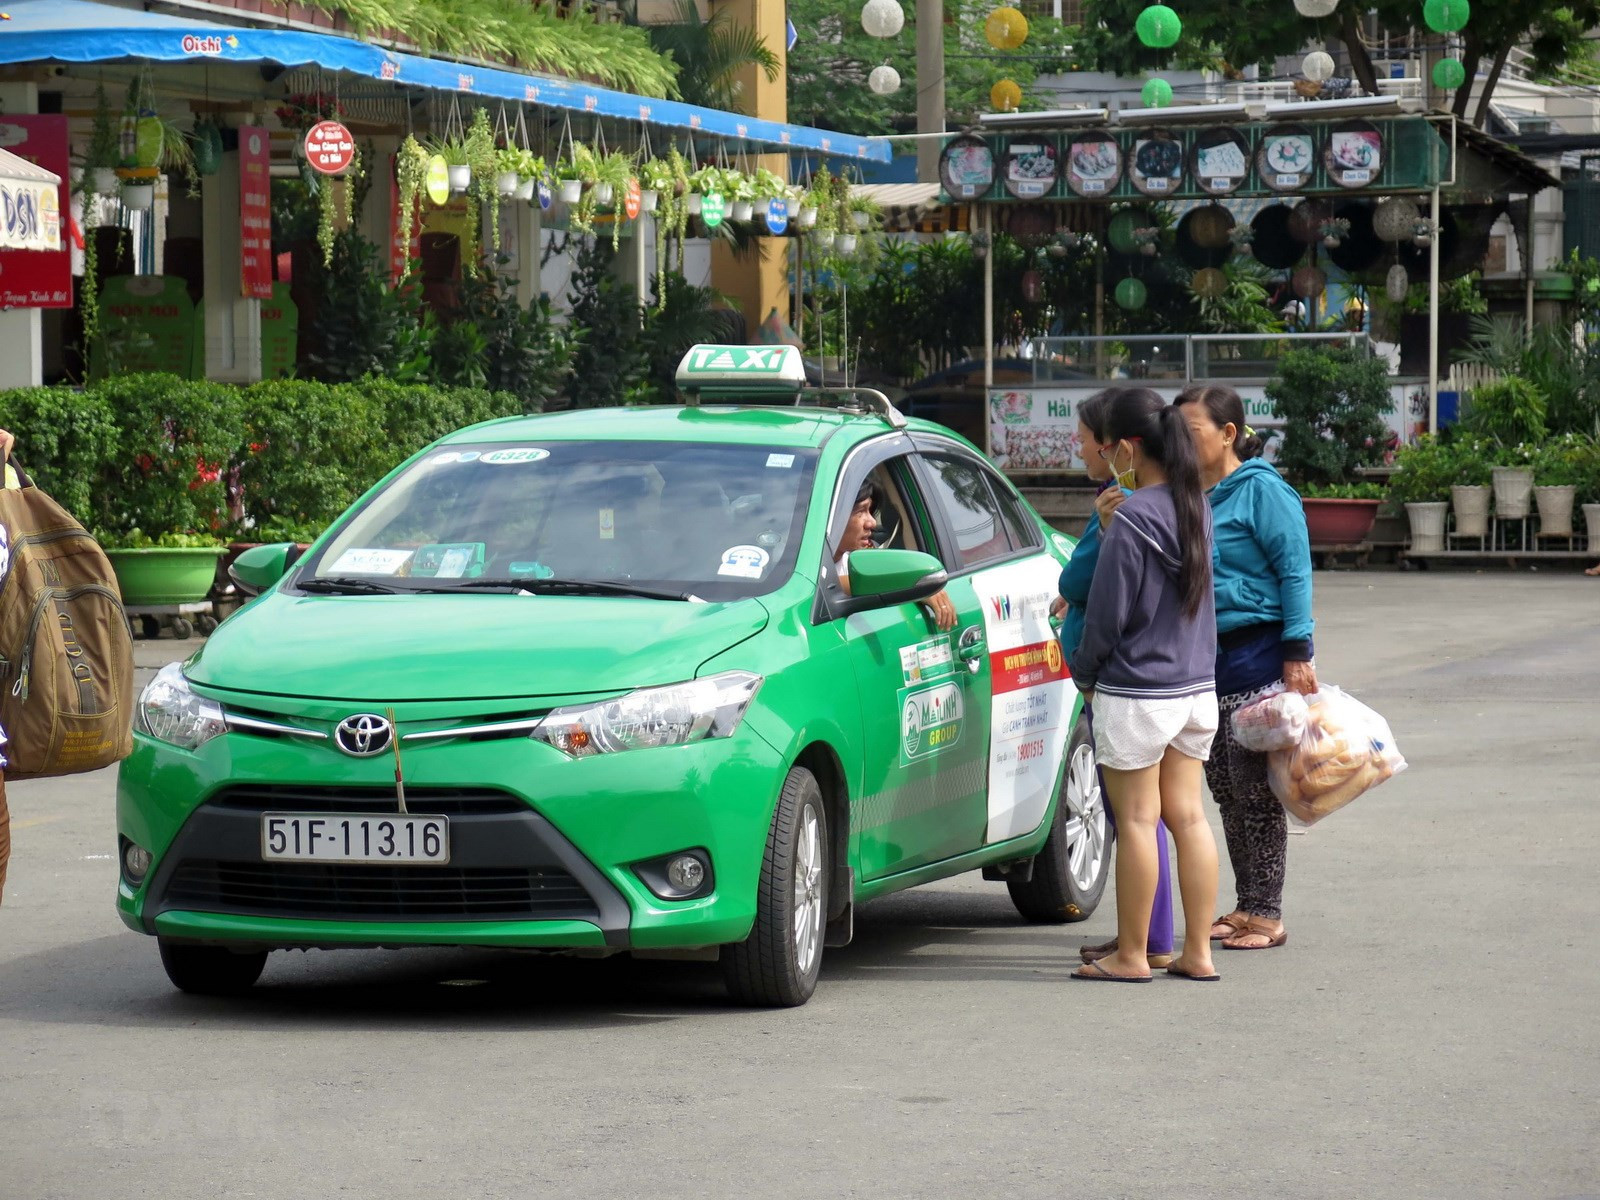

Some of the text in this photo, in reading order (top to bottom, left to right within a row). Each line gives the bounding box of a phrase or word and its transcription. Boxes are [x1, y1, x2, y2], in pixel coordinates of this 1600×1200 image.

[182, 34, 222, 54] Oishi
[1047, 397, 1071, 417] Hải
[929, 724, 958, 746] GROUP
[1017, 738, 1044, 762] 19001515
